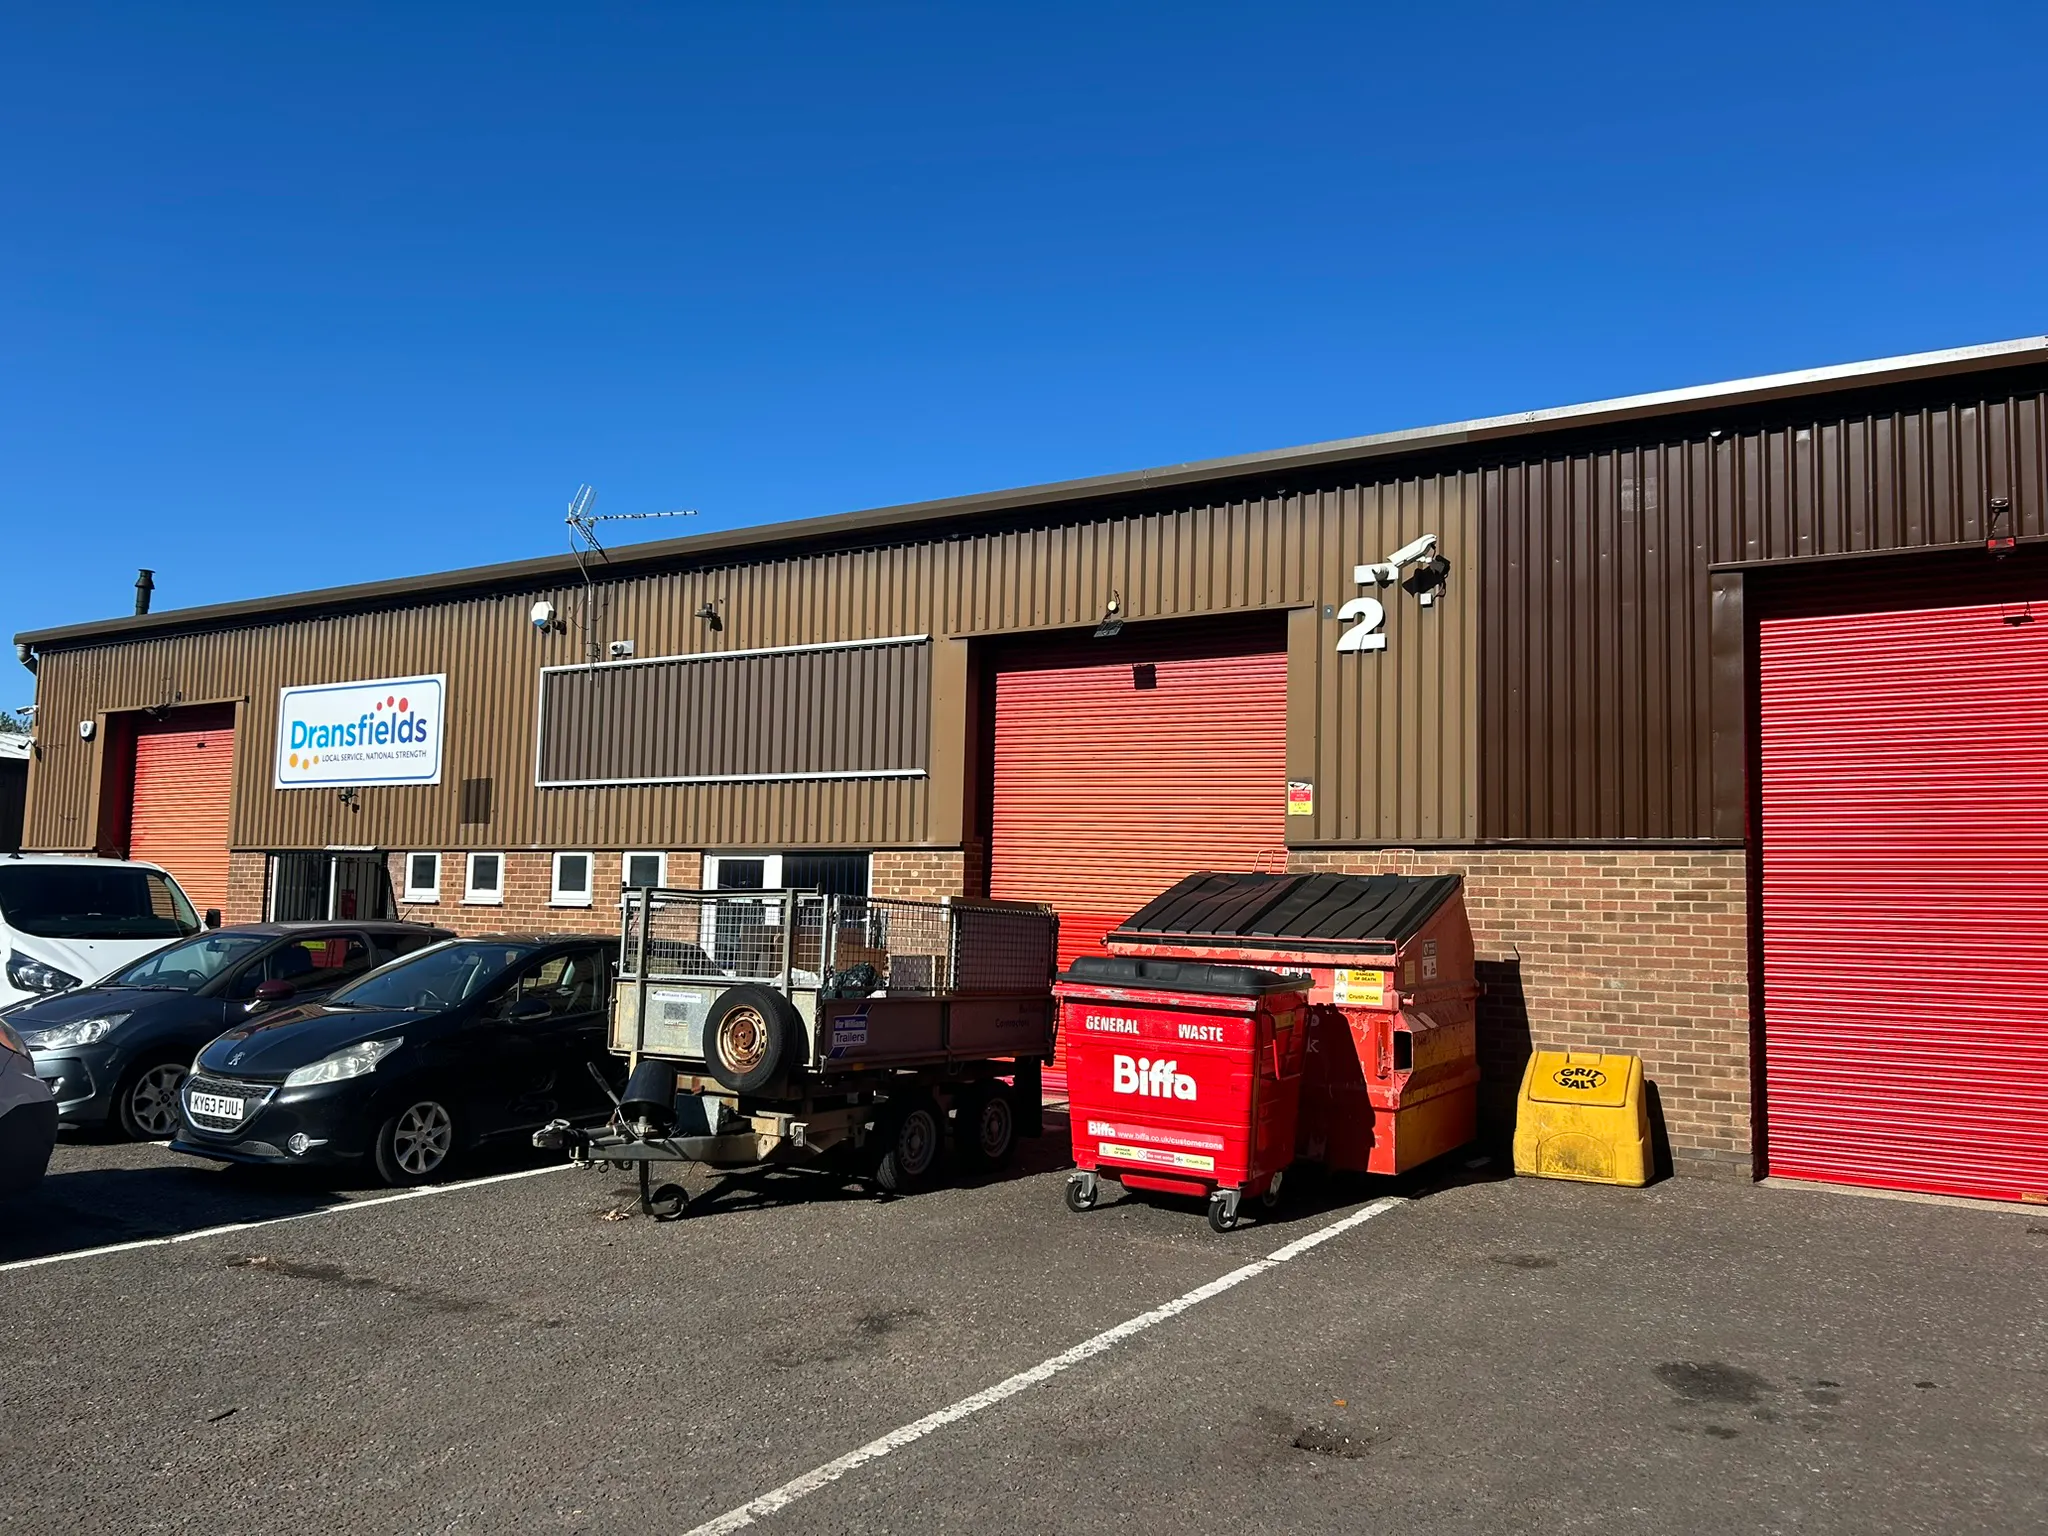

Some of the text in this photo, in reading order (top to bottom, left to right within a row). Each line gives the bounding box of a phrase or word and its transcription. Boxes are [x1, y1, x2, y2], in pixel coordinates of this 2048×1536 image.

[1336, 597, 1386, 651] 2
[290, 711, 427, 750] Dransfields
[322, 750, 427, 762] LOCAL SERVICE, NATIONAL STRENGTH
[835, 1032, 865, 1043] Trailers
[1085, 1015, 1224, 1042] GENERAL WASTE
[1113, 1054, 1197, 1101] Biffa
[1558, 1077, 1597, 1090] SALT
[1560, 1067, 1603, 1078] GRIT
[193, 1095, 239, 1116] KY63 FUU
[1087, 1120, 1223, 1150] Biffa www.biffa.co.uk/customerzone
